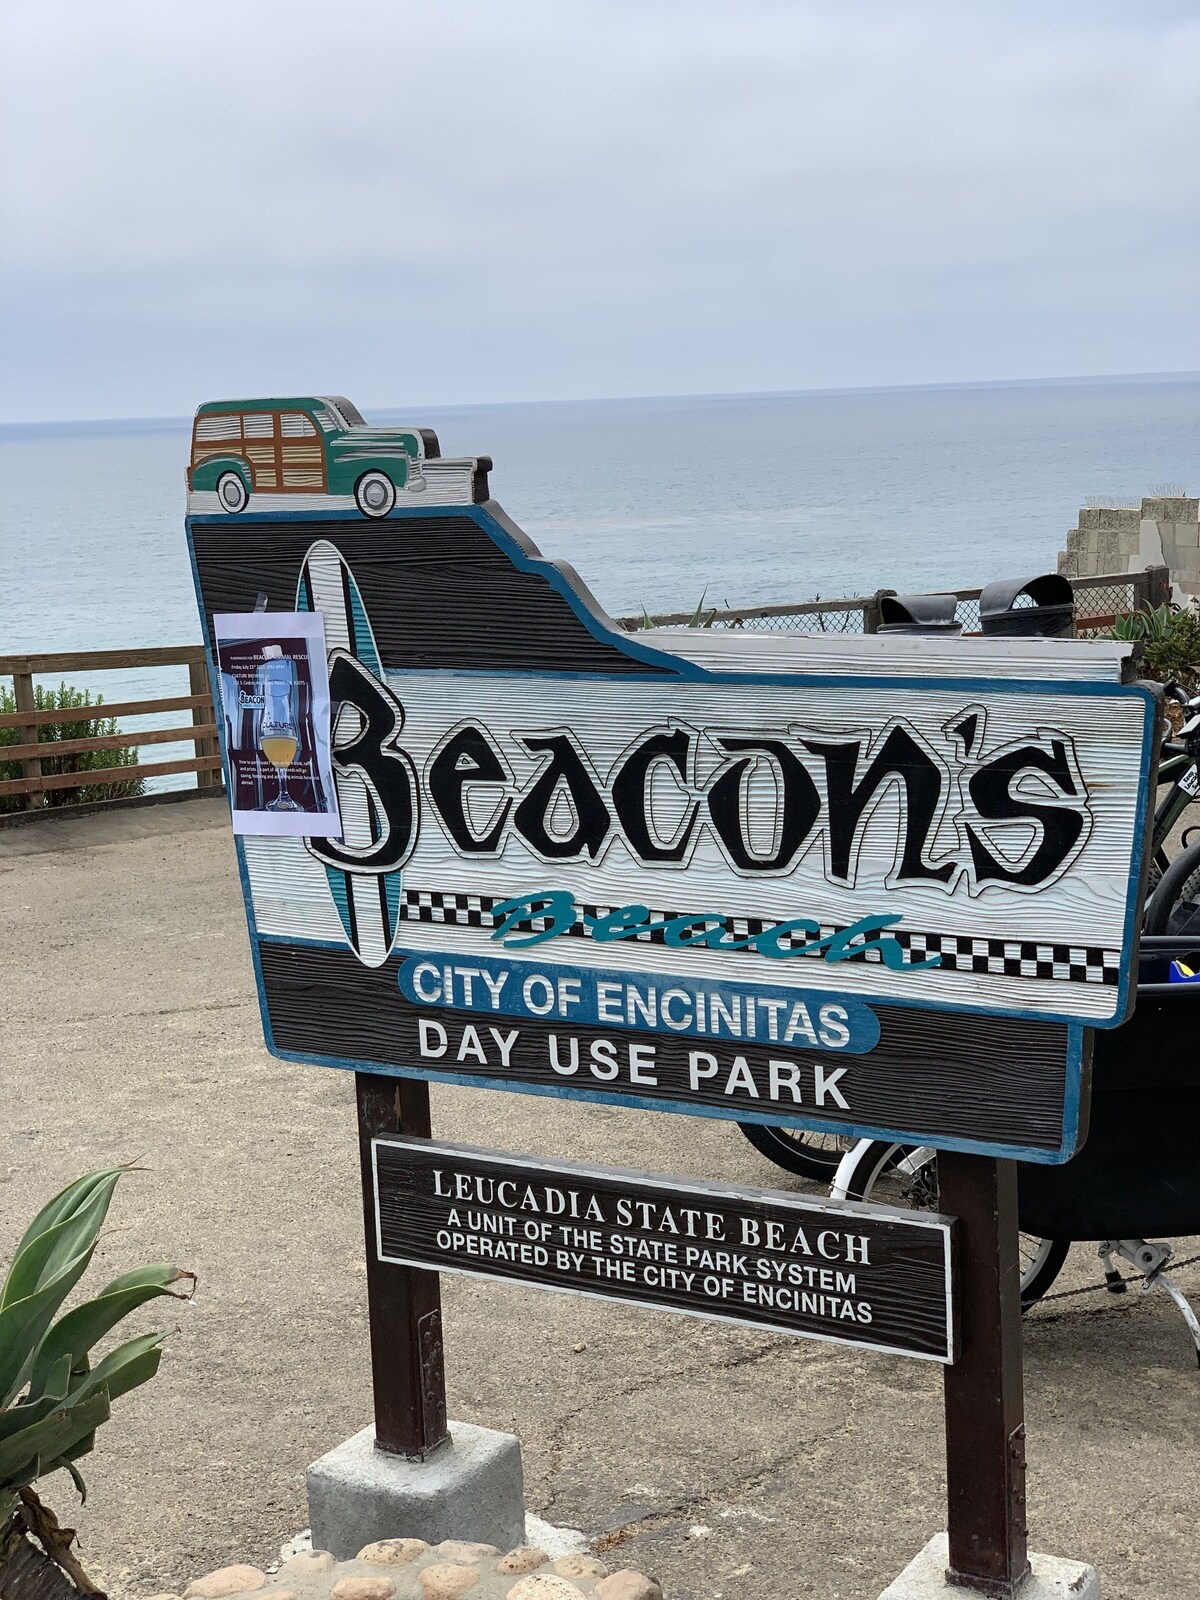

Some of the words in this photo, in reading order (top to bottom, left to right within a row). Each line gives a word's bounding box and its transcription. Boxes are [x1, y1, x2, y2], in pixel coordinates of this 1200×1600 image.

[240, 692, 265, 704] BEACON
[262, 721, 293, 730] CULTURE
[306, 649, 1088, 890] Beacon's
[489, 889, 942, 971] Beach
[412, 961, 509, 1010] CITY
[523, 973, 582, 1017] OF
[597, 981, 851, 1048] ENCINITAS
[418, 1018, 519, 1067] DAY
[548, 1034, 658, 1086] USE
[688, 1051, 851, 1110] PARK
[432, 1170, 606, 1223] LEUCADIA
[616, 1199, 726, 1242] STATE
[739, 1217, 872, 1266] BEACH
[447, 1208, 462, 1228] A
[468, 1212, 517, 1236] UNIT
[524, 1221, 553, 1242] OF
[558, 1225, 603, 1252] THE
[610, 1234, 678, 1264] STATE
[686, 1247, 750, 1277] PARK
[756, 1258, 857, 1294] SYSTEM
[436, 1230, 549, 1267] OPERATED
[556, 1252, 586, 1273] BY
[596, 1257, 636, 1283] THE
[643, 1265, 697, 1292] CITY
[703, 1275, 735, 1299] OF
[743, 1282, 873, 1324] ENCINITAS
